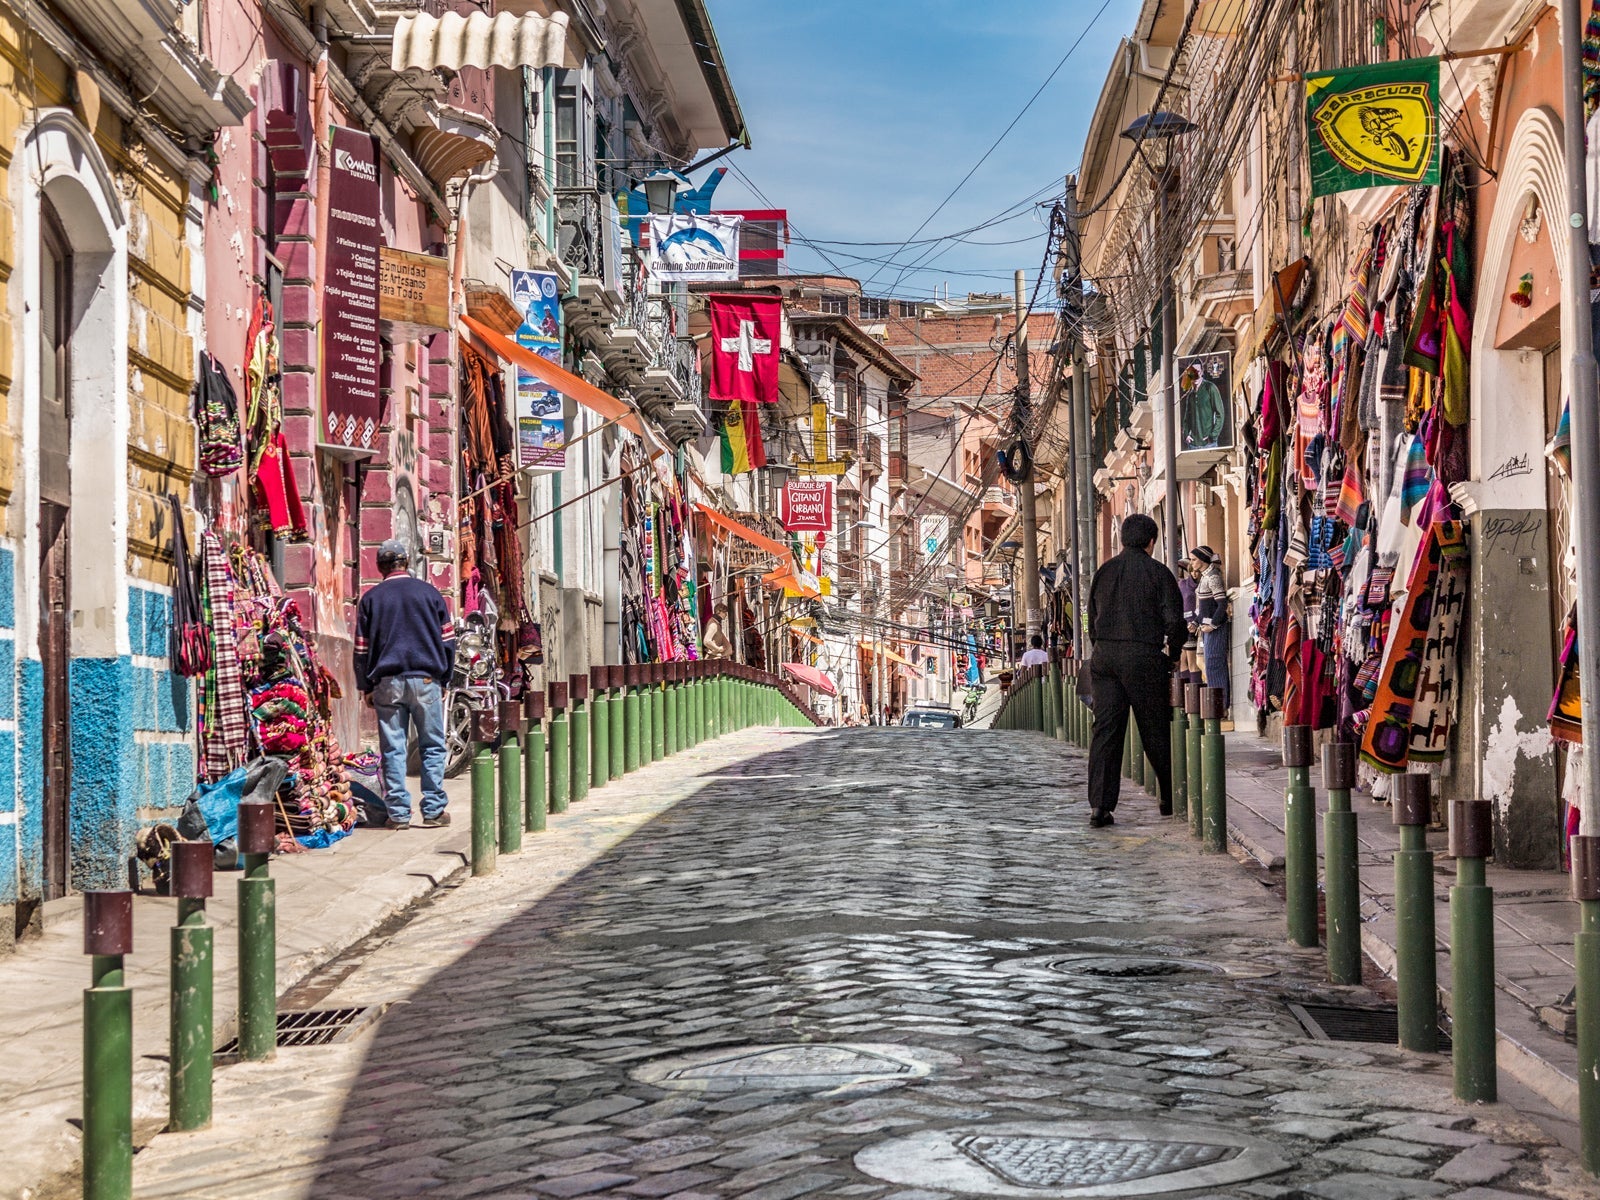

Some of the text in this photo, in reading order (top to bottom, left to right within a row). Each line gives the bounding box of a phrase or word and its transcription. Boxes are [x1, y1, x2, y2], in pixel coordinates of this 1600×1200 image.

[330, 208, 376, 228] PRODUCTOS
[340, 237, 356, 248] Fieltro
[361, 244, 376, 253] mano
[652, 260, 734, 272] Climbing South America
[340, 268, 376, 283] Tejido en telar
[390, 273, 426, 290] Artesanos
[324, 285, 341, 296] Tejido
[350, 279, 376, 291] horizontal
[397, 286, 423, 301] Todos
[348, 298, 376, 310] tradicional
[342, 310, 376, 325] Instrumentos
[350, 321, 376, 332] musicales
[336, 332, 376, 346] Tejido de punto
[361, 346, 376, 354] mano
[345, 353, 376, 366] Torneado de
[356, 364, 376, 373] madera
[335, 371, 356, 382] Bordado
[361, 378, 376, 386] mano
[788, 481, 816, 490] BOUTIQUE
[791, 492, 821, 503] GITANO
[791, 503, 823, 514] URBANO
